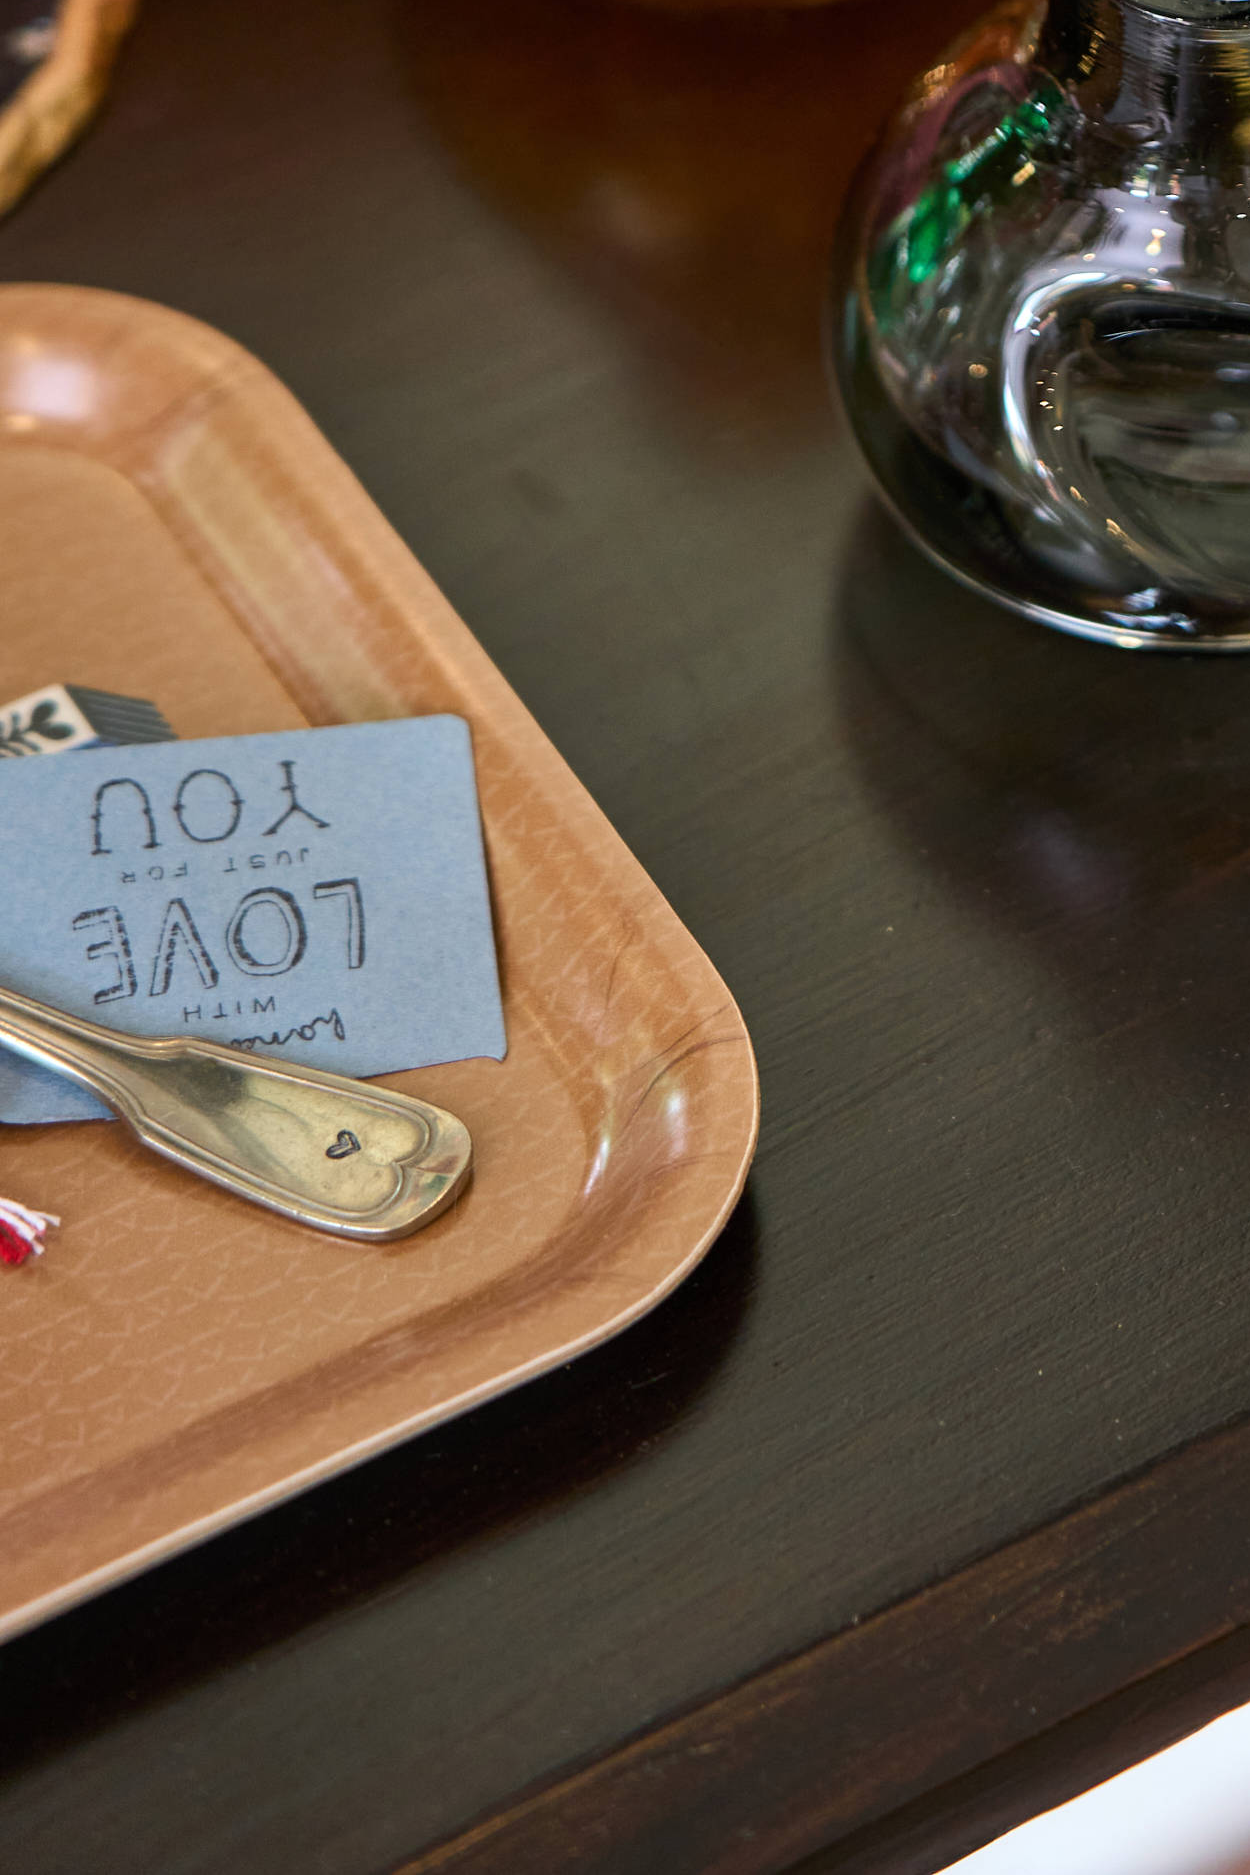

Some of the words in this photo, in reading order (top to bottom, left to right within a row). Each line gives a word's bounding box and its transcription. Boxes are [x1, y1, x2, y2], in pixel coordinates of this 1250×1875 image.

[91, 760, 330, 855] YOU
[120, 863, 188, 883] FOR
[224, 848, 310, 872] JUST
[72, 878, 366, 1005] LOVE
[184, 996, 276, 1022] WITH
